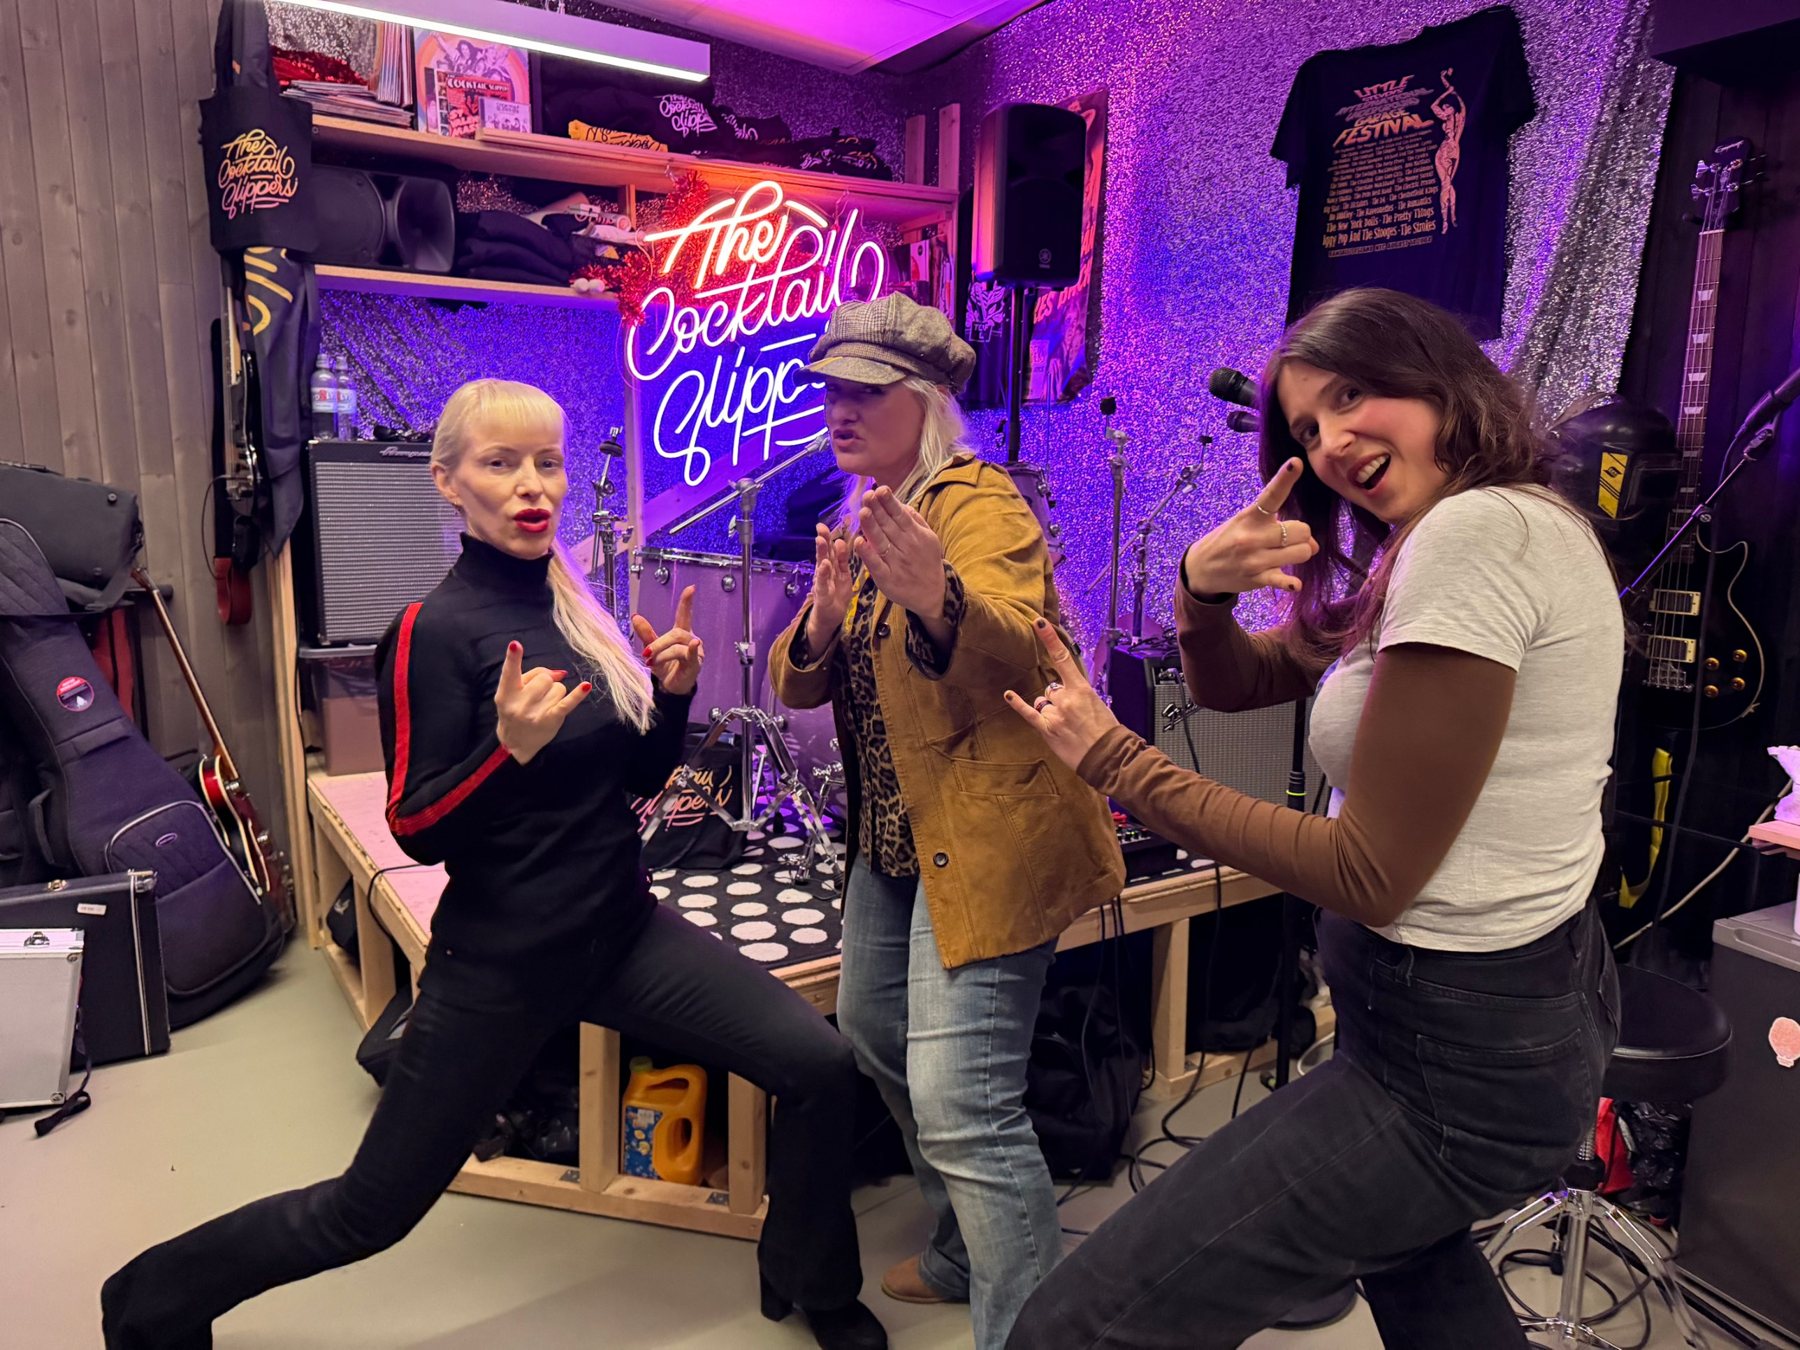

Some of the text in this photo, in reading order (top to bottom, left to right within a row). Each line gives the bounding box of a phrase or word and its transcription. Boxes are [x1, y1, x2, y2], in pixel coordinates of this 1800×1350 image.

[1354, 75, 1415, 99] LITTLE
[221, 128, 278, 159] The
[1332, 114, 1435, 147] FESTIVAL
[218, 145, 295, 189] Cocktail
[222, 174, 299, 220] Slippers
[642, 180, 828, 290] The
[627, 207, 885, 381] Cocktail
